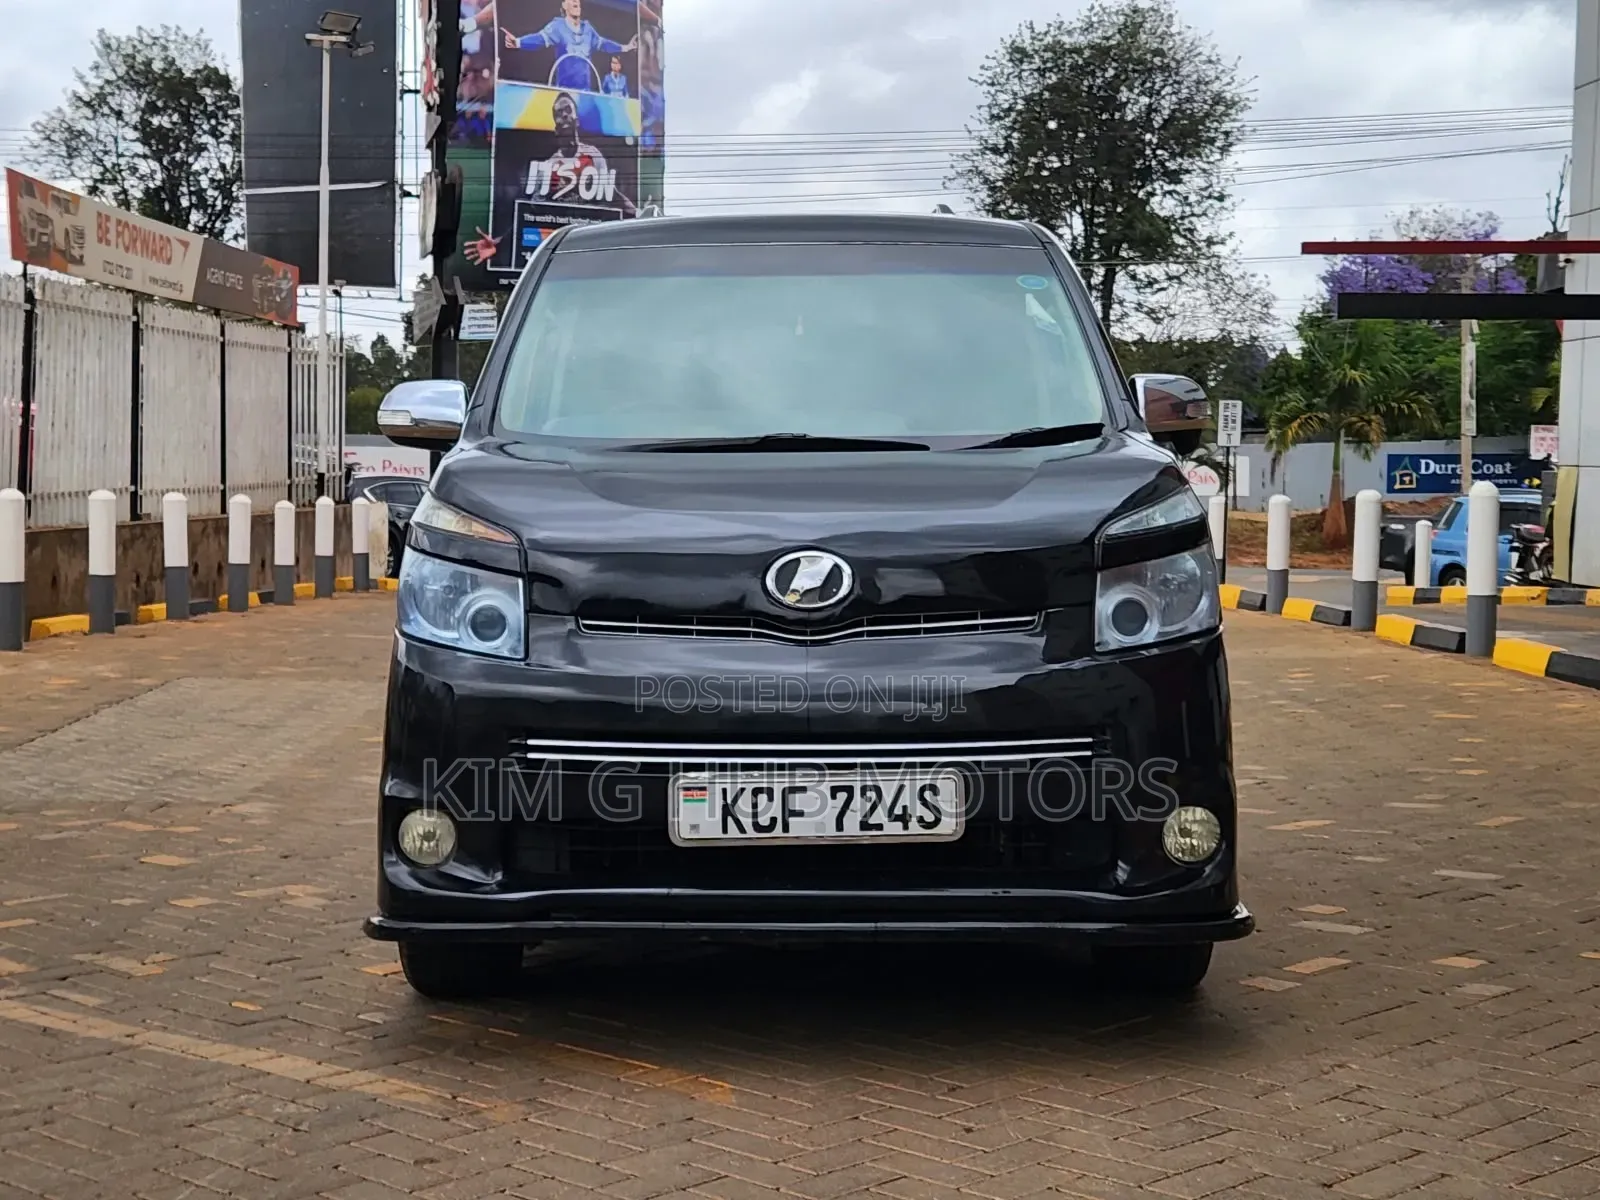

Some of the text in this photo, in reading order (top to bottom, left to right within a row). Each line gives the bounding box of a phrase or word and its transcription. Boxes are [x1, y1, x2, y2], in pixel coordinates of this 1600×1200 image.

[578, 166, 617, 202] ON
[96, 211, 173, 266] BE FORWARD
[206, 267, 244, 291] AGENT OFFICE
[721, 783, 942, 834] KCF 724S
